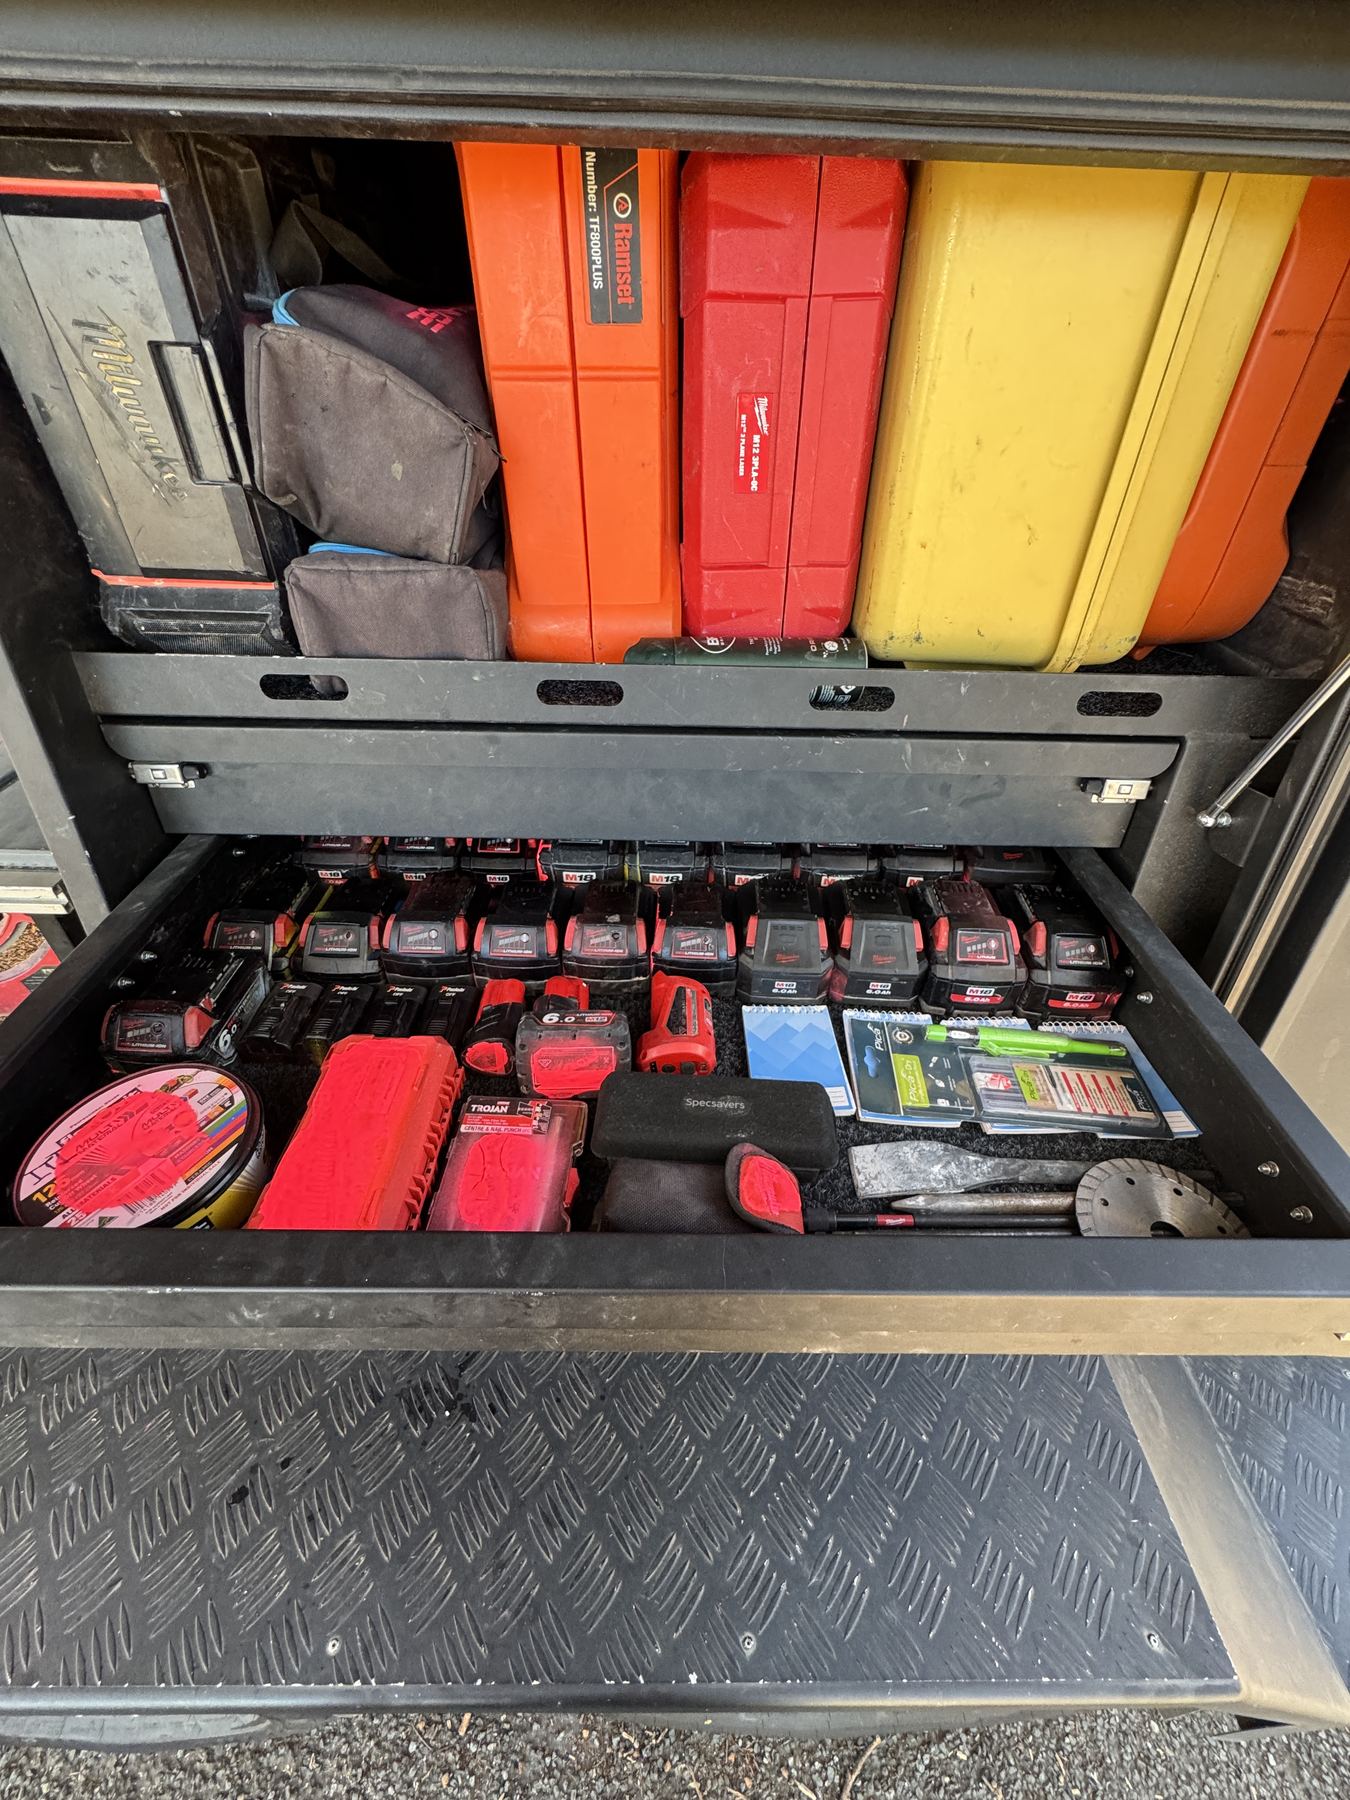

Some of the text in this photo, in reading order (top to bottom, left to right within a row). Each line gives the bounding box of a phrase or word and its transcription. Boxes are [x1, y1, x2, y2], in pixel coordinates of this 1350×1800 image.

[585, 151, 603, 290] Number: TF800PLUS
[614, 223, 635, 305] Ramset
[752, 434, 761, 454] M12
[564, 874, 595, 882] M18
[1068, 993, 1093, 1001] M18
[542, 1012, 576, 1024] 6.0
[867, 1022, 884, 1051] Pica
[471, 1104, 509, 1113] TROJAN
[685, 1098, 746, 1110] Specsavers
